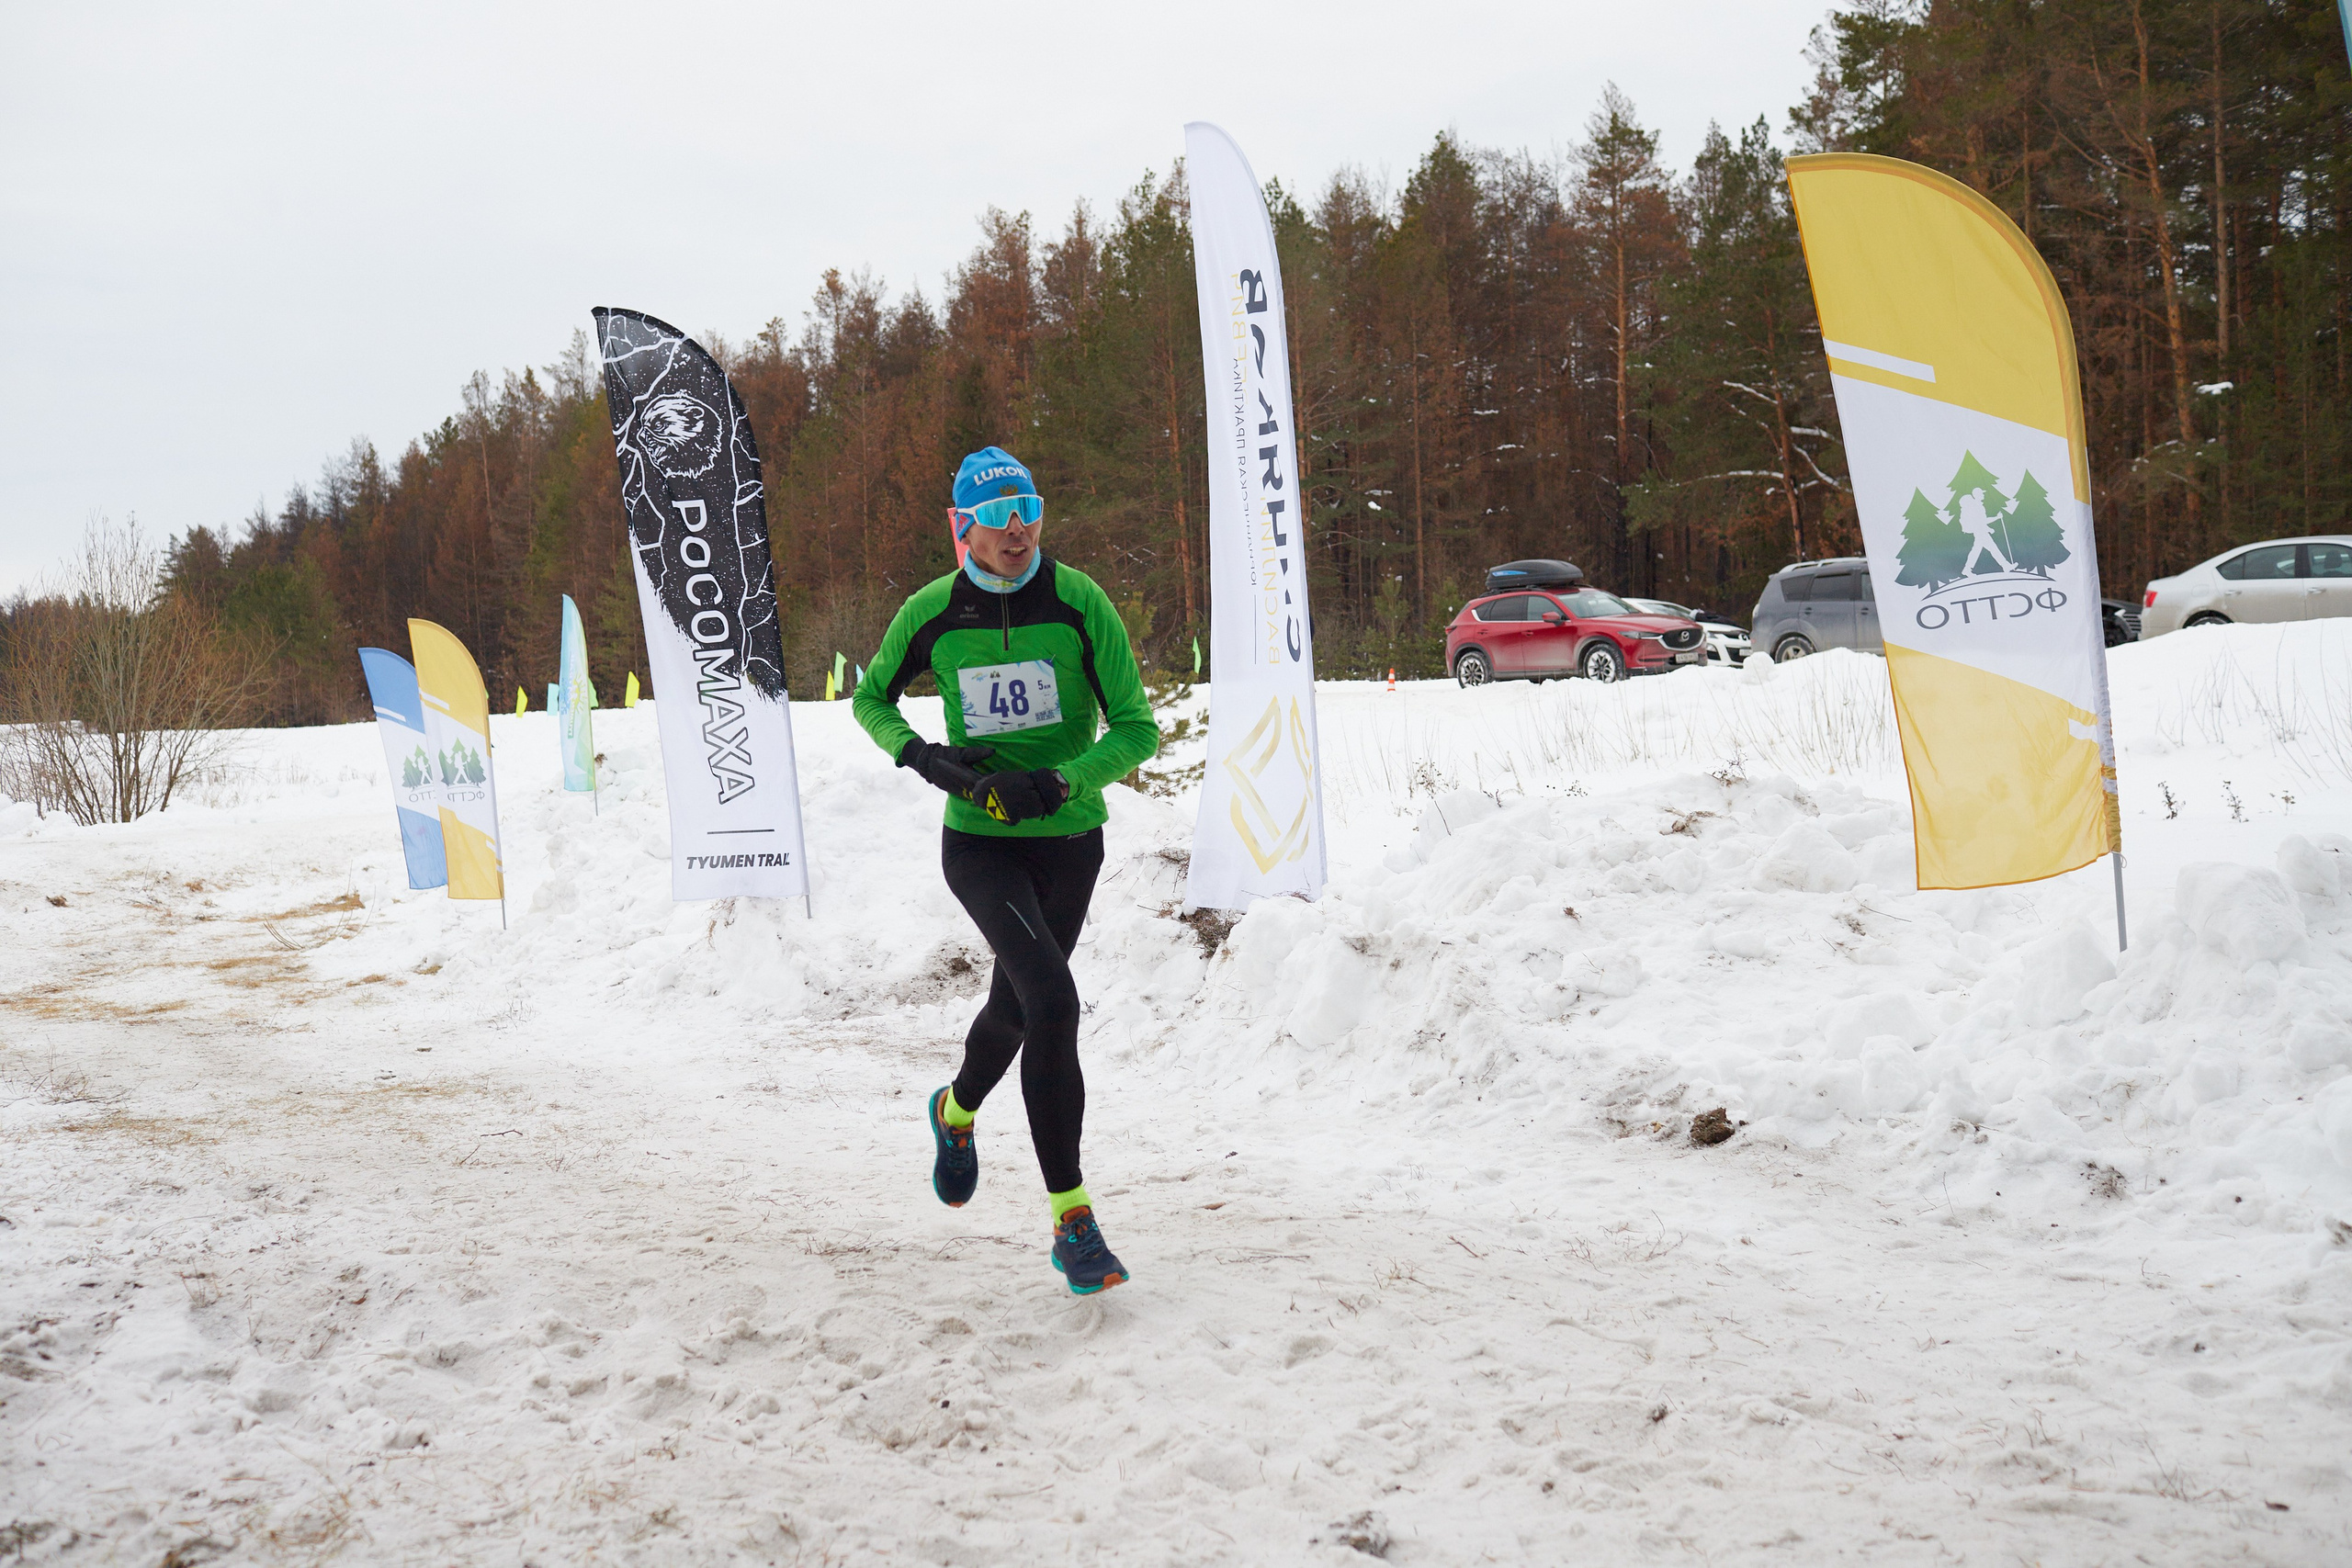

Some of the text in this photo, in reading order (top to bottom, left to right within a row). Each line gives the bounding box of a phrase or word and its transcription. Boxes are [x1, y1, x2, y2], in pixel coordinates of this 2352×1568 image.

[974, 466, 1027, 486] LUKOIL
[1037, 680, 1044, 691] 5
[989, 680, 1029, 718] 48
[686, 854, 755, 870] TYUMEN
